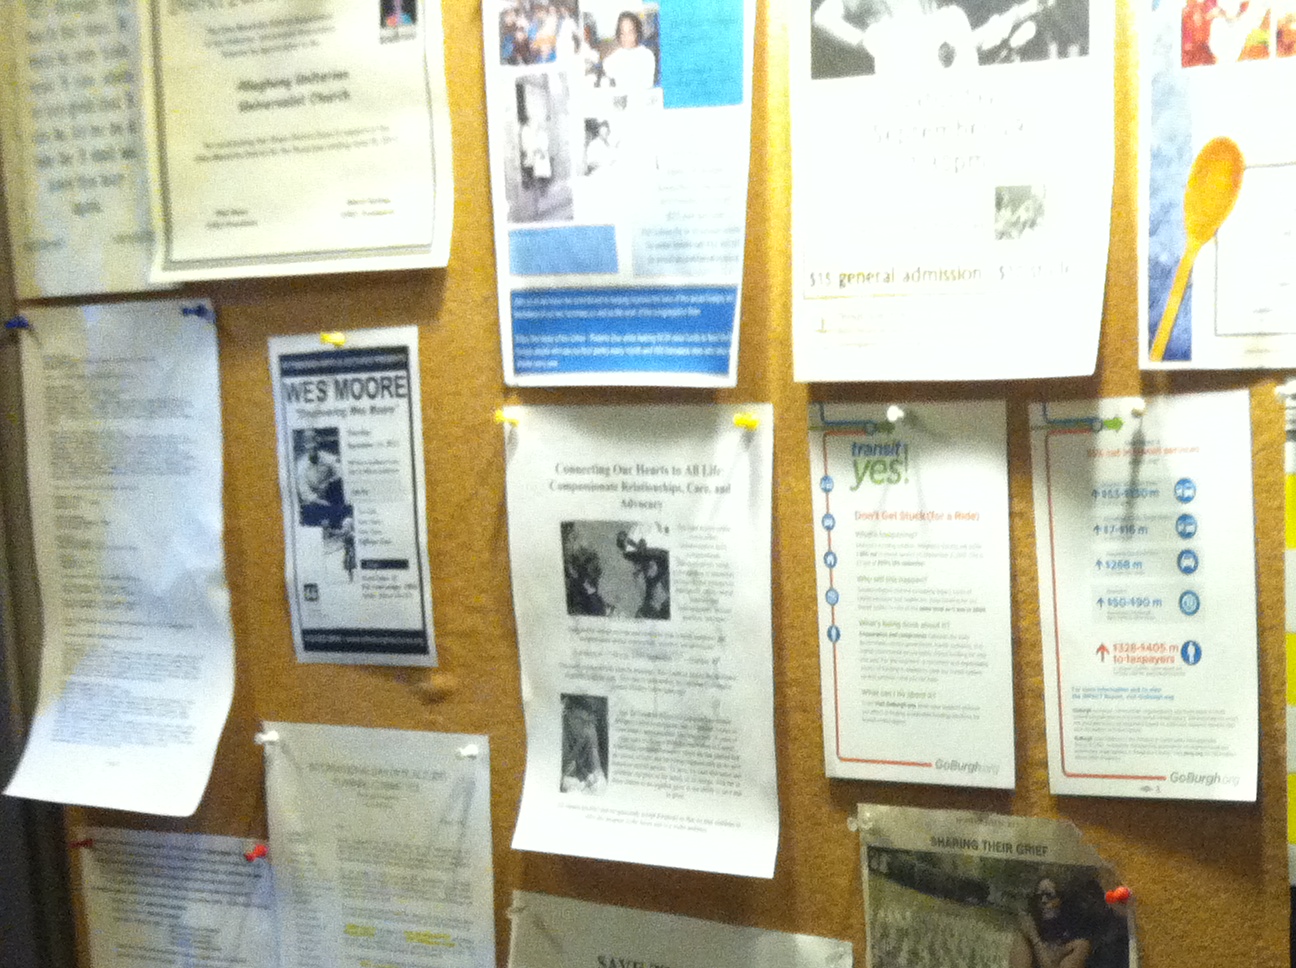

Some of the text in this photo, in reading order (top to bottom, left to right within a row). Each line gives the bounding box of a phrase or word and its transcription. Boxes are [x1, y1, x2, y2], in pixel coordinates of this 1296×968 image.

[837, 264, 983, 289] general admission
[333, 374, 409, 401] MOORE
[1169, 771, 1241, 788] GoBurgh.org
[930, 836, 1049, 857] SHARING THEIR GRIEF
